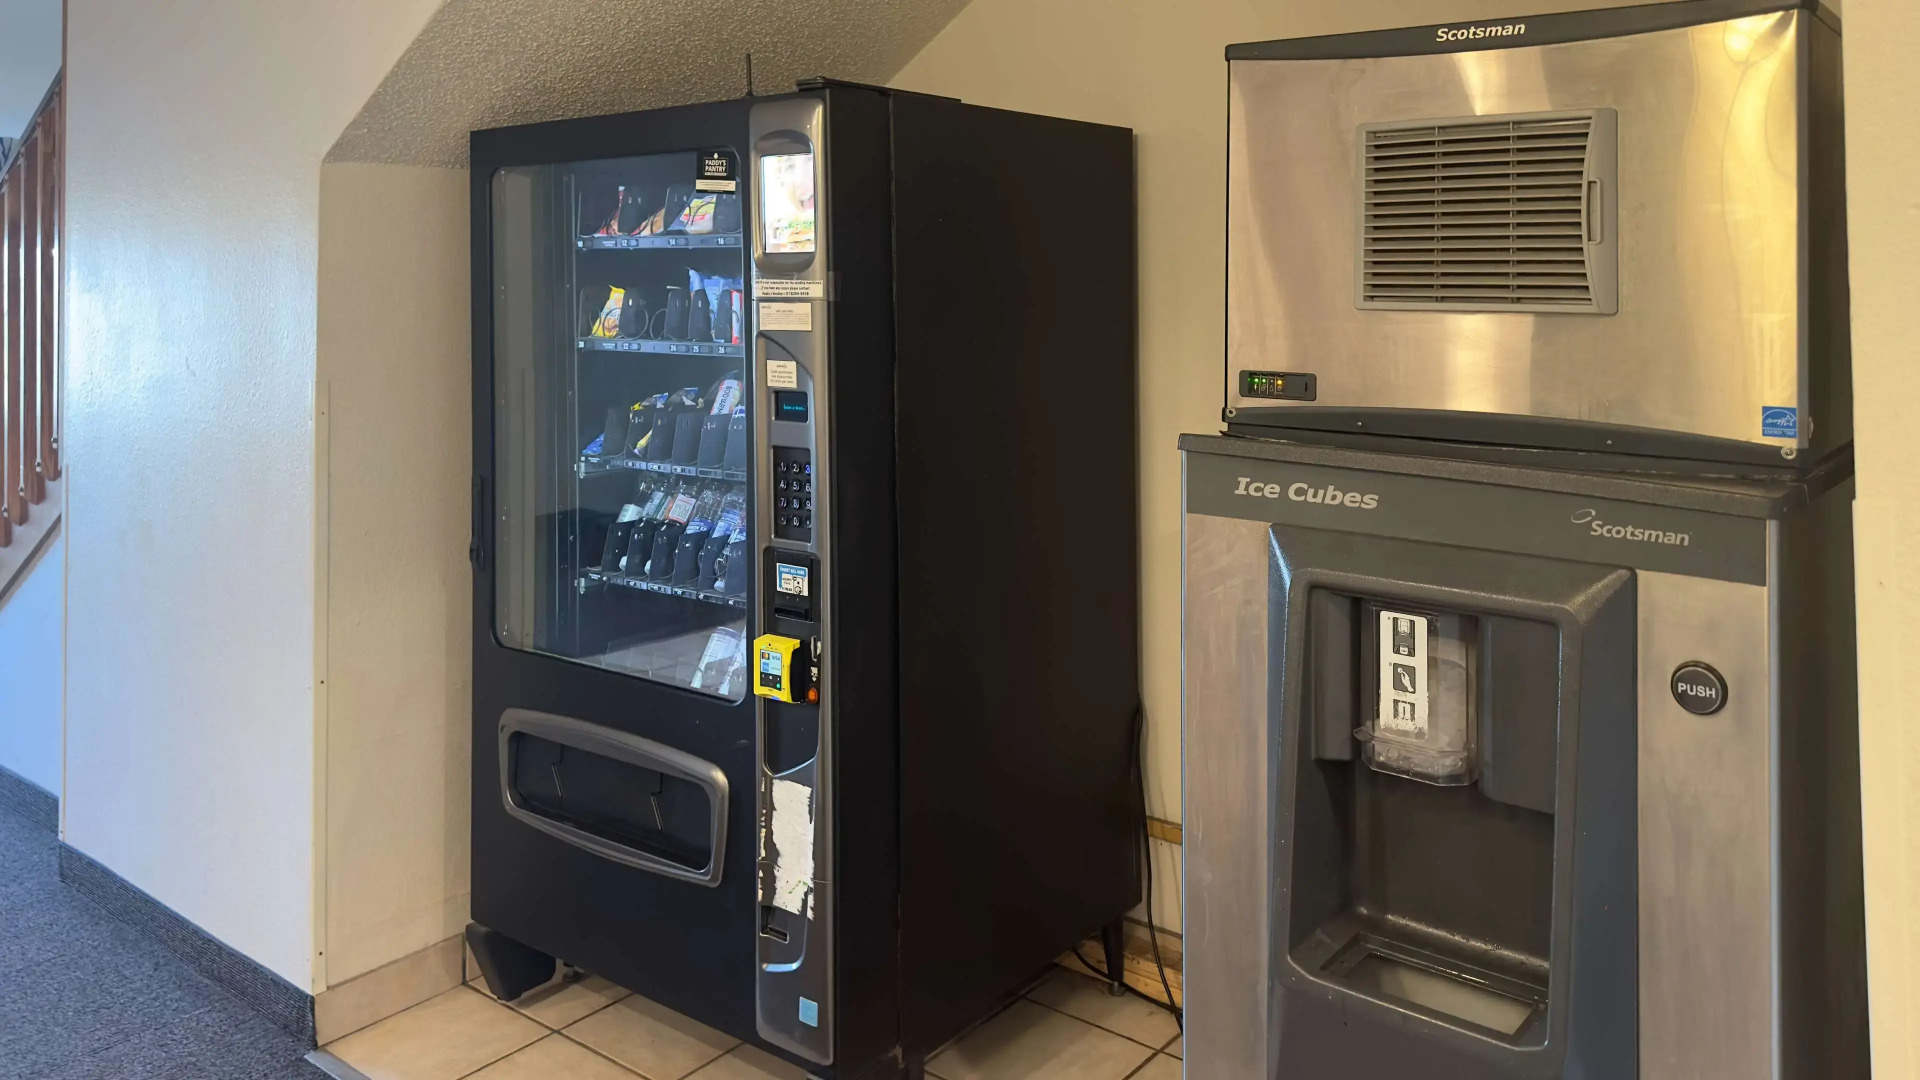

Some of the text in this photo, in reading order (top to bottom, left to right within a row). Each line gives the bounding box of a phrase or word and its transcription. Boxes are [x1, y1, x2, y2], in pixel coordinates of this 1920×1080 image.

[1436, 23, 1526, 42] Scotsman
[621, 239, 628, 247] 12
[717, 237, 725, 245] 16
[670, 344, 677, 352] 24
[692, 345, 699, 353] 25
[1234, 477, 1379, 509] Ice Cubes
[1590, 520, 1690, 546] Scotsman
[1677, 682, 1716, 699] PUSH
